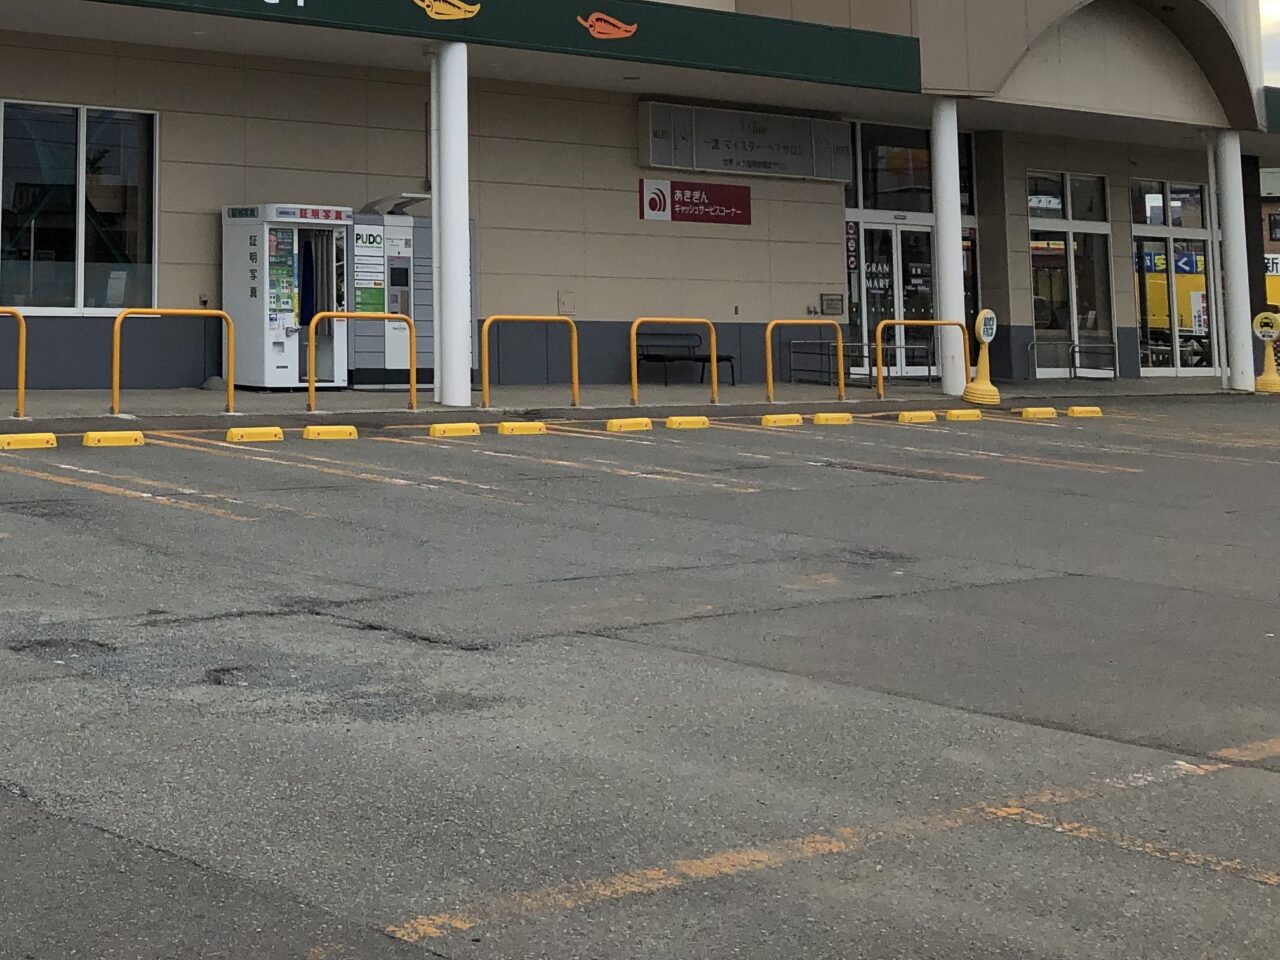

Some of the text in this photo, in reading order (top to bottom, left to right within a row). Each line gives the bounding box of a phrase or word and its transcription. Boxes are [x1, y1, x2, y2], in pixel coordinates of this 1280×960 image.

[674, 189, 709, 203] あきぎん
[299, 207, 342, 221] 証明写真
[674, 204, 742, 217] キャッシュサービスコーナー
[355, 233, 382, 245] PUDO
[249, 234, 258, 298] 証明写真
[865, 262, 889, 273] GRAN
[866, 278, 889, 289] MART
